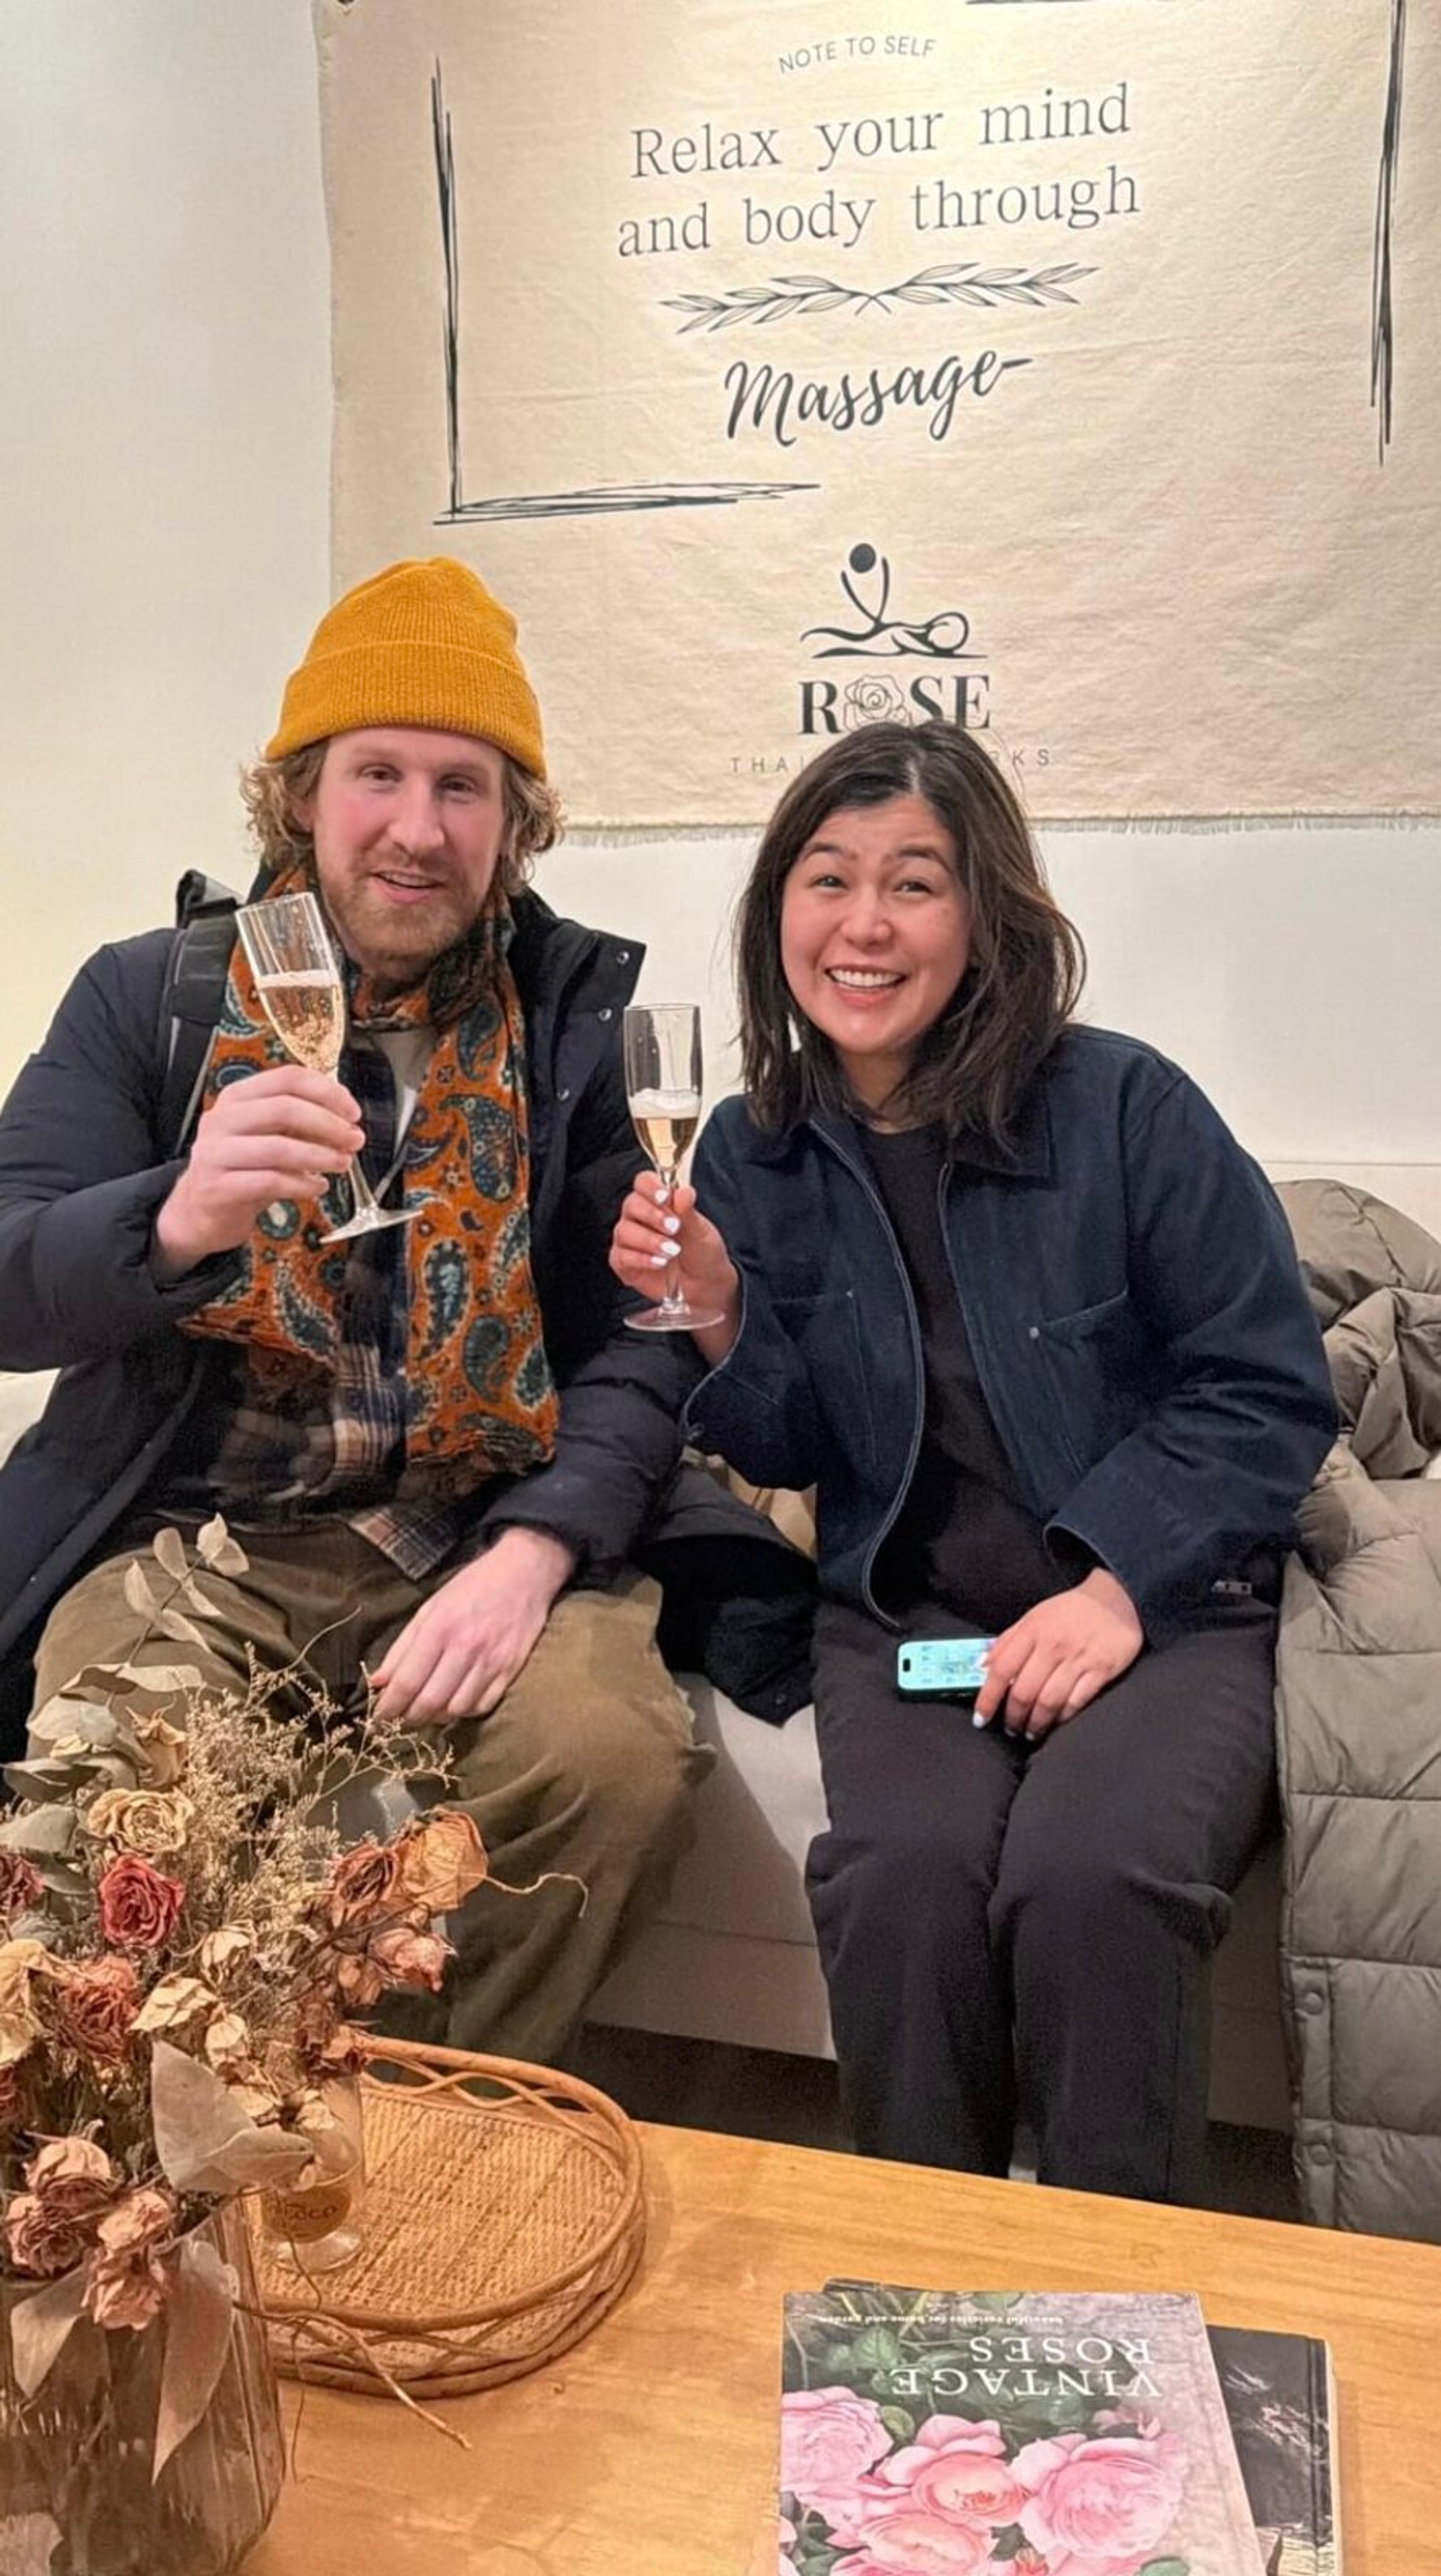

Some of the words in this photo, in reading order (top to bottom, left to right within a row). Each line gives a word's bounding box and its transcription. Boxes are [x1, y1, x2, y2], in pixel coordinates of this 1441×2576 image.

[778, 41, 837, 74] NOTE
[845, 36, 875, 56] TO
[884, 35, 936, 57] SELF
[630, 123, 782, 178] Relax
[815, 112, 944, 172] your
[979, 81, 1131, 145] mind
[618, 202, 711, 257] and
[743, 189, 876, 248] body
[911, 165, 1141, 230] through
[724, 350, 1034, 447] Massage
[730, 755, 805, 773] THAI
[970, 2337, 1153, 2364] ROSES
[891, 2368, 1162, 2396] VINTAGE
